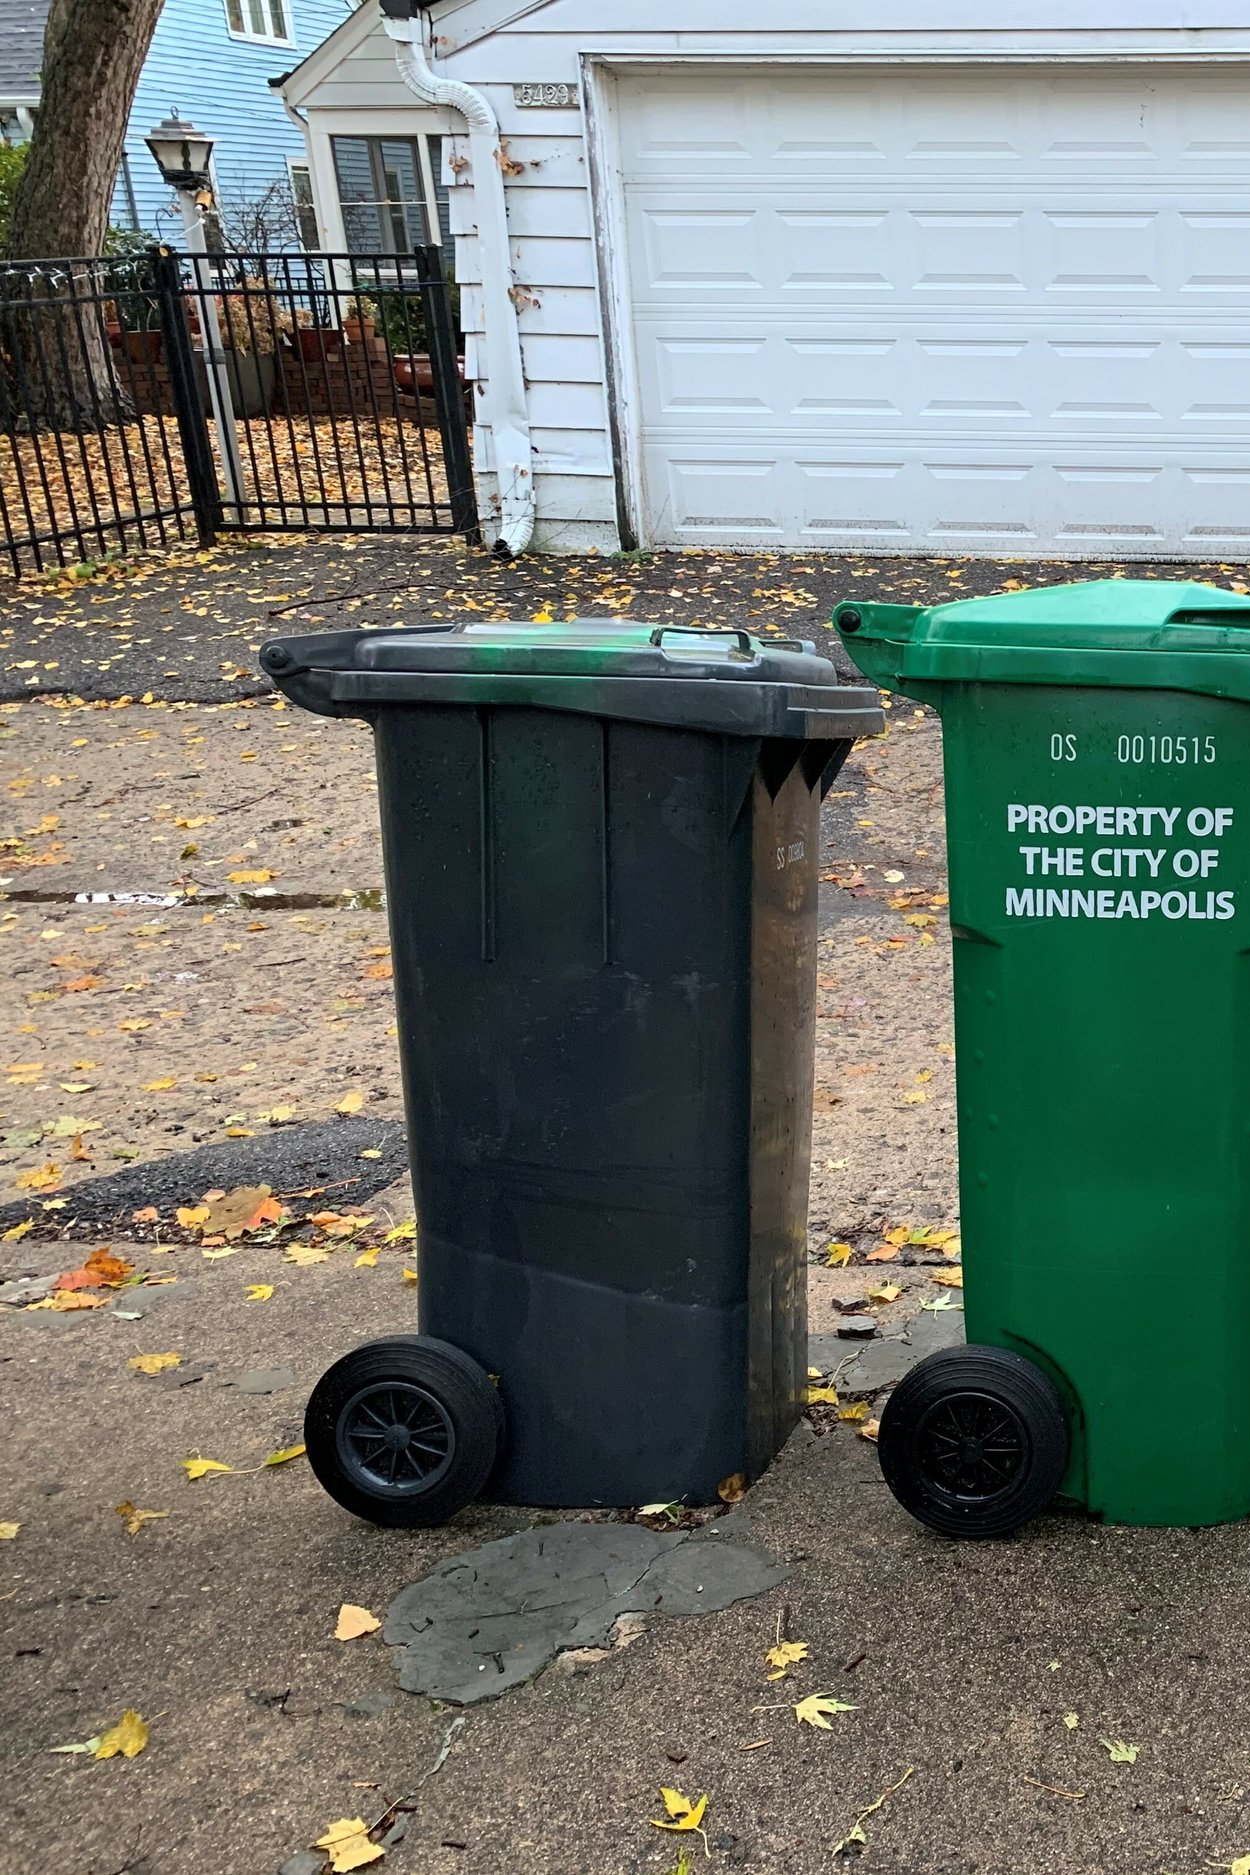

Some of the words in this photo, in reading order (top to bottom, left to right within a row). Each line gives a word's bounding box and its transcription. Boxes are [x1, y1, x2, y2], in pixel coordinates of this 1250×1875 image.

[522, 84, 569, 105] 5429
[1117, 735, 1216, 764] 0010515
[1007, 804, 1182, 836] PROPERTY
[1187, 807, 1234, 837] OF
[1019, 846, 1084, 876] THE
[1091, 848, 1166, 878] CITY
[1172, 849, 1219, 878] OF
[1005, 887, 1235, 920] MINNEAPOLIS
